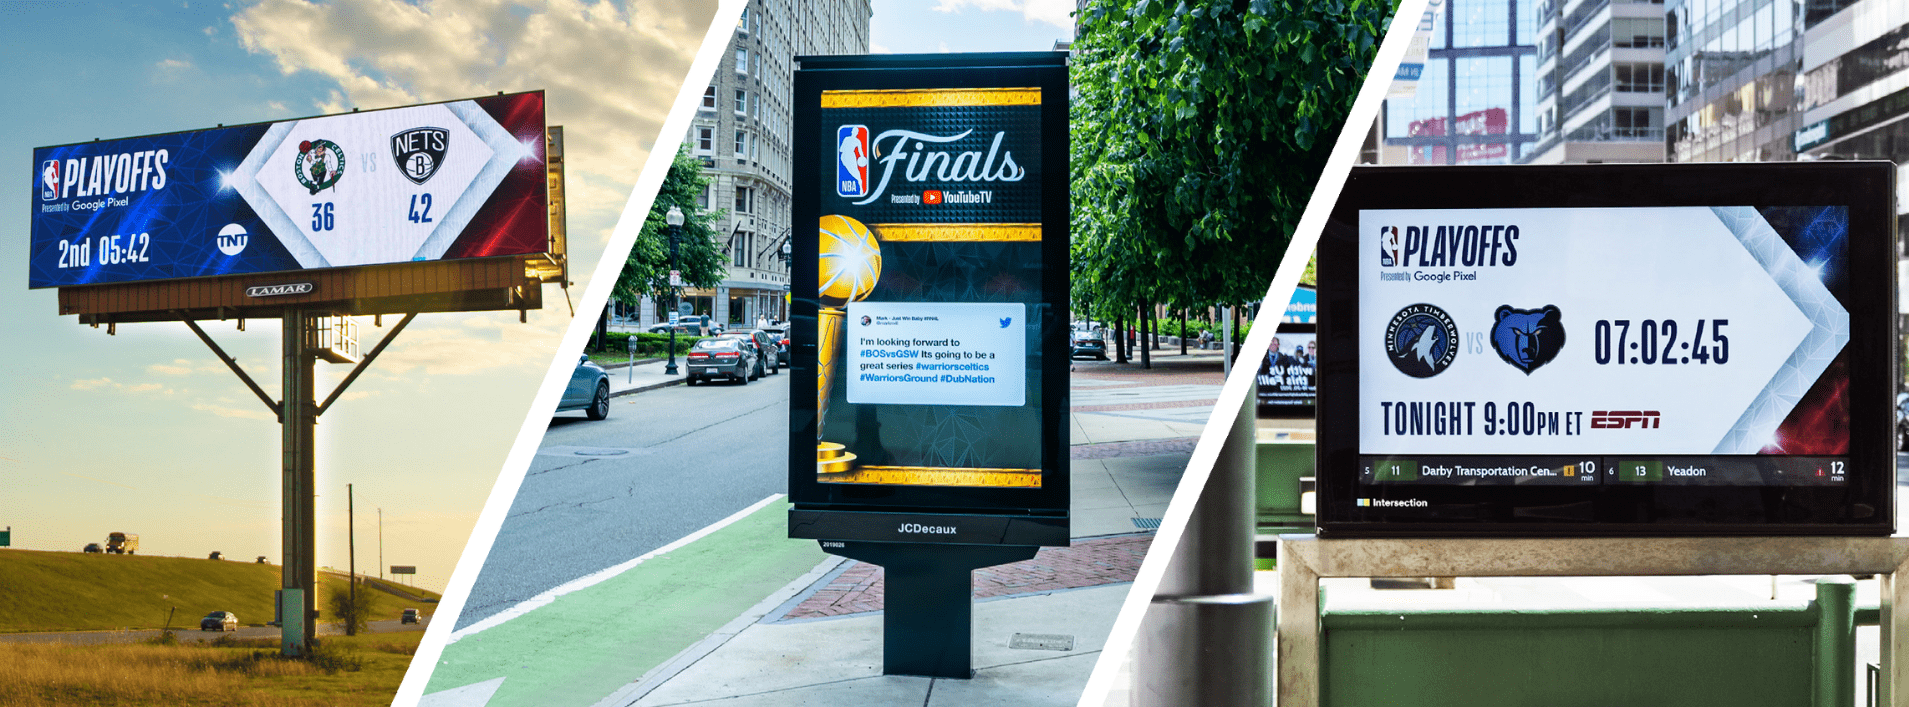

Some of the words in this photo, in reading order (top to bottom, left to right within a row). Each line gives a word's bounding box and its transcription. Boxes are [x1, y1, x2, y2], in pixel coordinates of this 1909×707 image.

[395, 130, 445, 156] NETS
[296, 153, 307, 184] BOSTON
[331, 144, 345, 175] CELTICS
[361, 152, 376, 173] VS
[415, 156, 424, 176] B
[852, 128, 1025, 206] Finals
[62, 149, 169, 198] PLAYOFFS
[841, 181, 857, 193] NBA
[72, 199, 105, 212] Google
[107, 196, 129, 208] Pixel
[891, 194, 914, 204] Presented
[914, 195, 920, 206] by
[943, 191, 992, 204] YouTubeTV
[311, 202, 335, 232] 36
[408, 193, 433, 224] 42
[217, 233, 248, 248] TNT
[1403, 225, 1520, 267] PLAYOFFS
[58, 238, 91, 269] 2nd
[99, 232, 150, 266] 05:42
[1380, 271, 1405, 281] Presented
[1405, 271, 1411, 283] by
[1414, 271, 1451, 283] Google
[1453, 271, 1477, 281] Pixel
[251, 284, 306, 296] LAMAR
[1387, 306, 1419, 352] MINNESOTA
[1424, 305, 1457, 366] TIMBERWOLVES
[860, 338, 874, 346] I'm
[877, 338, 910, 348] looking
[912, 338, 948, 347] forward
[950, 339, 960, 347] to
[1466, 332, 1484, 355] VS
[1594, 319, 1729, 365] 07:02:45
[860, 349, 919, 358] #BOSvsGSW
[921, 350, 933, 359] Its
[935, 350, 961, 361] going
[963, 351, 973, 359] to
[975, 350, 987, 359] be
[989, 352, 995, 360] a
[860, 362, 884, 372] great
[886, 362, 914, 370] series
[916, 362, 989, 371] #warriorsceltics
[860, 374, 938, 383] #WarriorsGround
[940, 374, 995, 384] #DubNation
[1381, 401, 1476, 436] TONIGHT
[1566, 412, 1583, 436] ET
[1591, 410, 1661, 429] ESPN
[1364, 466, 1370, 475] 5
[1391, 466, 1400, 475] 11
[1422, 465, 1453, 478] Darby
[1455, 465, 1528, 479] Transportation
[1579, 461, 1596, 474] 10
[1581, 474, 1594, 482] min
[1608, 467, 1614, 475] 6
[1635, 466, 1647, 476] 13
[1667, 465, 1707, 476] Yeadon
[1831, 461, 1845, 474] 12
[1831, 474, 1844, 482] min
[1373, 498, 1428, 508] Intersection
[897, 523, 957, 534] JCDecaux
